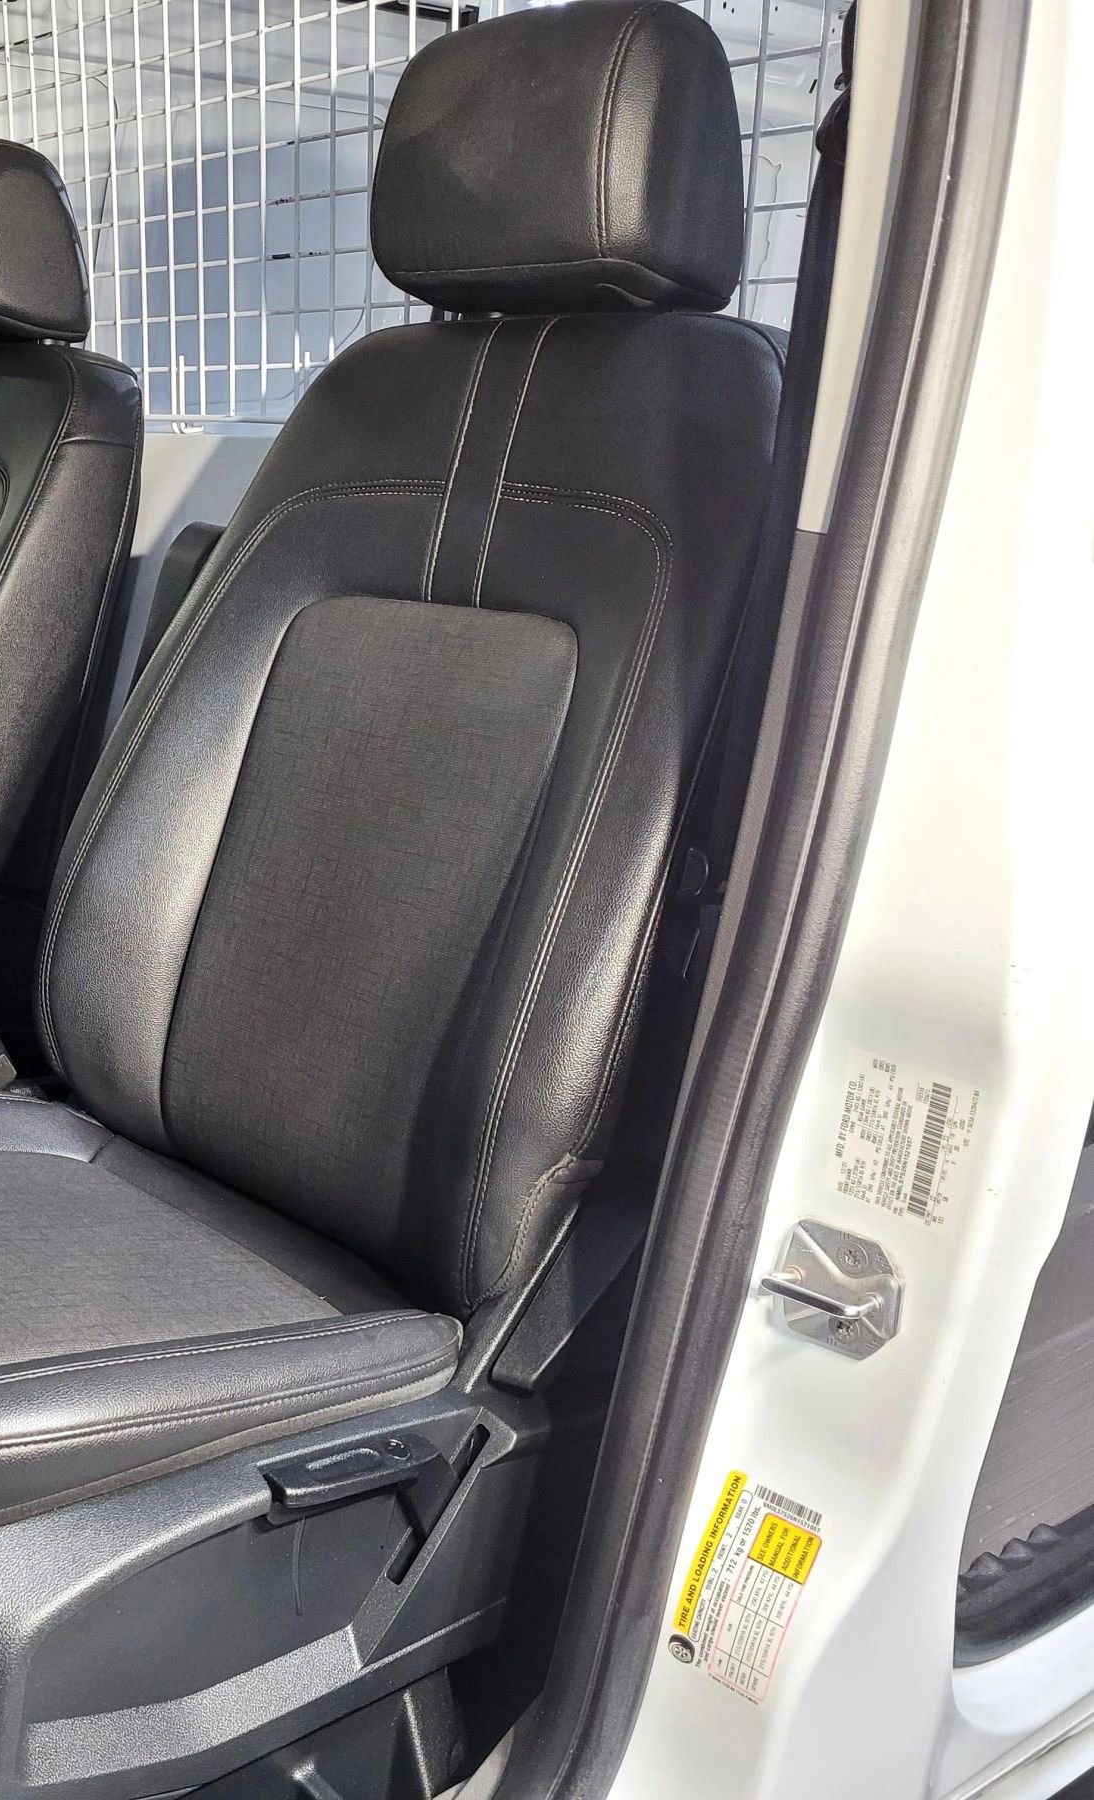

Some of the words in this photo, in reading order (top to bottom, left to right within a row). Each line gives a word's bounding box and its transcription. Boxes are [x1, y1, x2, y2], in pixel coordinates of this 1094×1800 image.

[848, 1078, 857, 1090] CO.
[843, 1090, 854, 1113] MOTOR
[840, 1114, 850, 1131] FORD
[838, 1131, 846, 1141] BY
[834, 1140, 844, 1157] MFD.
[742, 1517, 755, 1536] 1570
[678, 1605, 689, 1627] TIRE
[685, 1584, 696, 1604] AND
[692, 1540, 713, 1582] LOADING
[709, 1474, 741, 1538] INFORMATION
[733, 1546, 744, 1557] kg
[739, 1538, 746, 1546] or
[756, 1548, 766, 1561] SEE
[762, 1521, 778, 1548] OWNERS
[768, 1540, 784, 1567] MANUAL
[779, 1526, 789, 1540] FOR
[780, 1534, 801, 1571] ADDITIONAL
[726, 1558, 737, 1574] 712
[792, 1535, 814, 1579] INFORMATION
[690, 1619, 700, 1639] SEATING
[695, 1598, 706, 1620] CAPACITY
[698, 1632, 708, 1657] combined
[705, 1614, 714, 1632] weight
[712, 1580, 725, 1607] occupants
[706, 1636, 714, 1651] cargo
[710, 1618, 718, 1636] should
[721, 1583, 730, 1602] exceed
